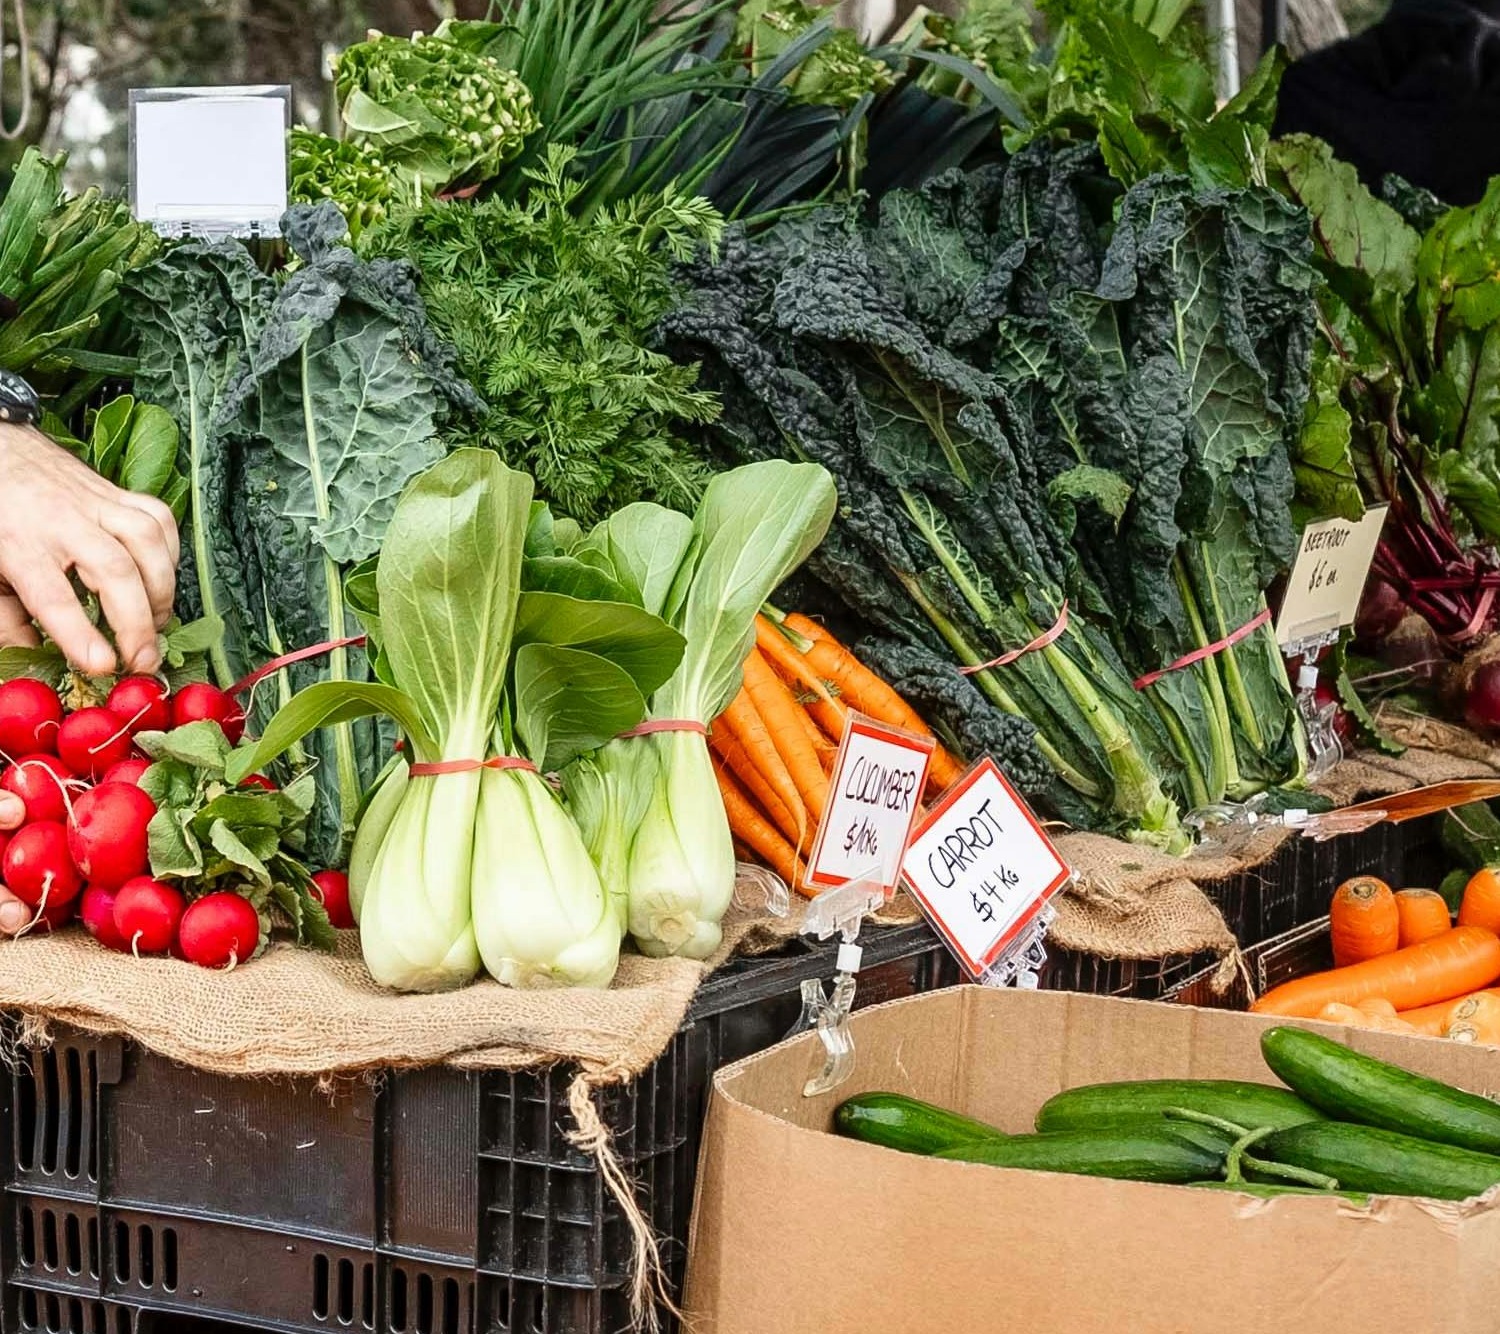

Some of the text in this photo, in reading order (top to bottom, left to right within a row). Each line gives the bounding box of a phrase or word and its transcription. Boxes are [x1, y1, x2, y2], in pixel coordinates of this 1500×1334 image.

[1304, 527, 1351, 553] BEETROOT
[845, 756, 917, 813] CUCUMBER
[927, 798, 1004, 889] CARROT
